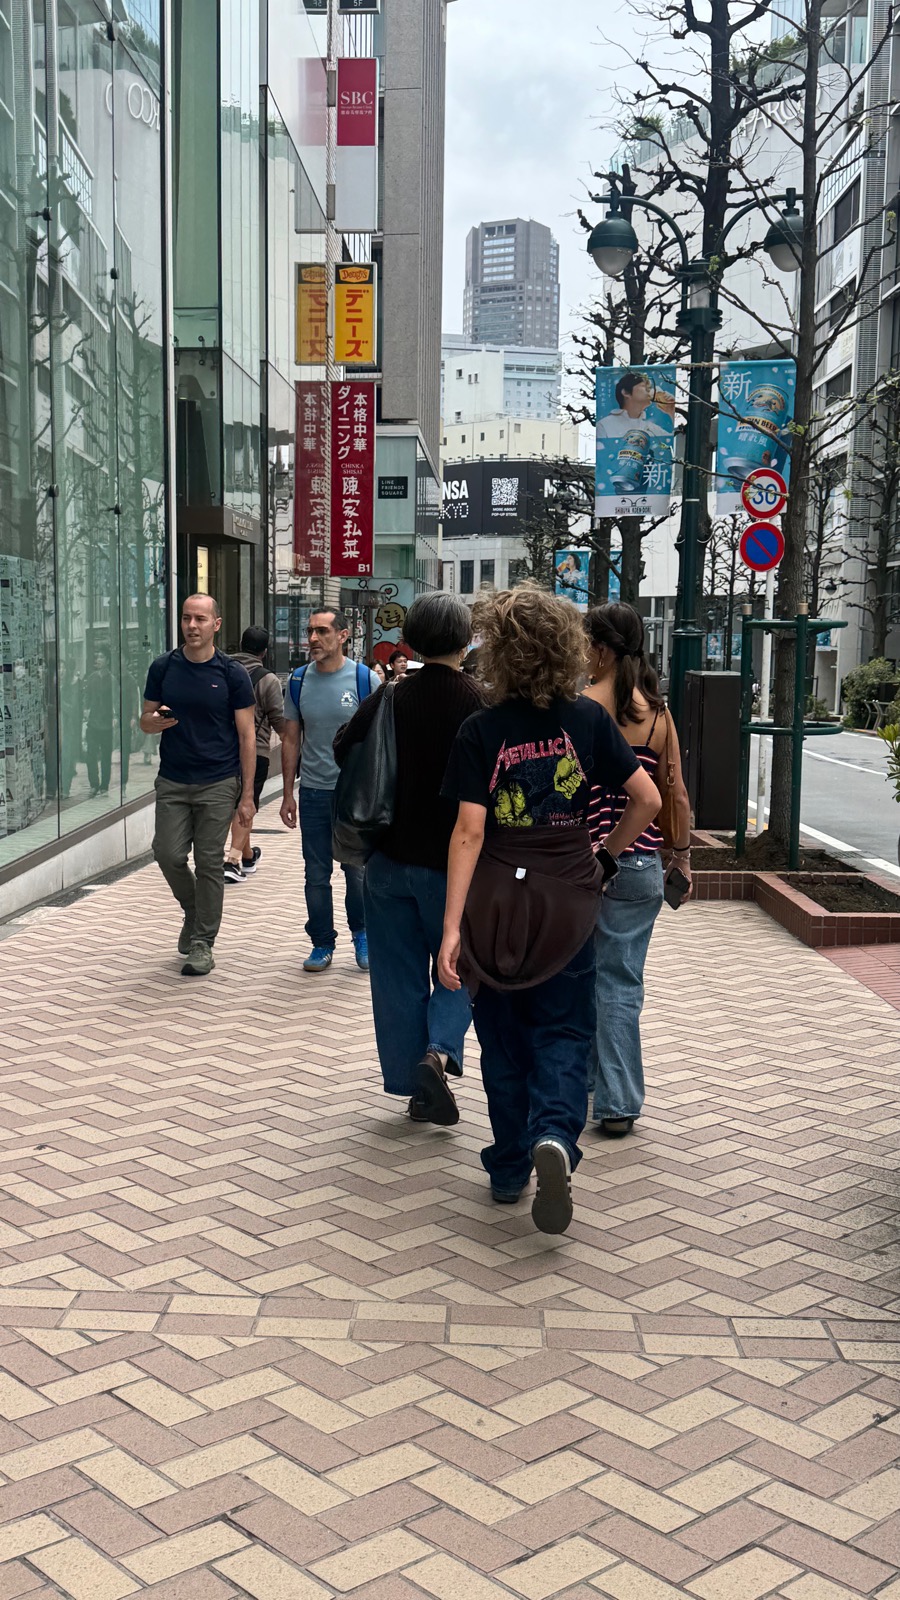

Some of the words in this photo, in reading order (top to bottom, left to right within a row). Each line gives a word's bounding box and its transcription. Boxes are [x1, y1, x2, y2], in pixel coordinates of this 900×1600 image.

[340, 91, 373, 105] SBC
[341, 269, 368, 280] Denny's
[345, 289, 370, 357] デニーズ
[723, 371, 753, 402] 新
[337, 385, 351, 460] ダイニング
[353, 392, 368, 452] 本格中華
[642, 462, 669, 488] 新
[752, 483, 777, 505] 30
[341, 476, 363, 559] 陳家私菜
[358, 563, 371, 573] B1
[489, 726, 588, 794] METALLICA
